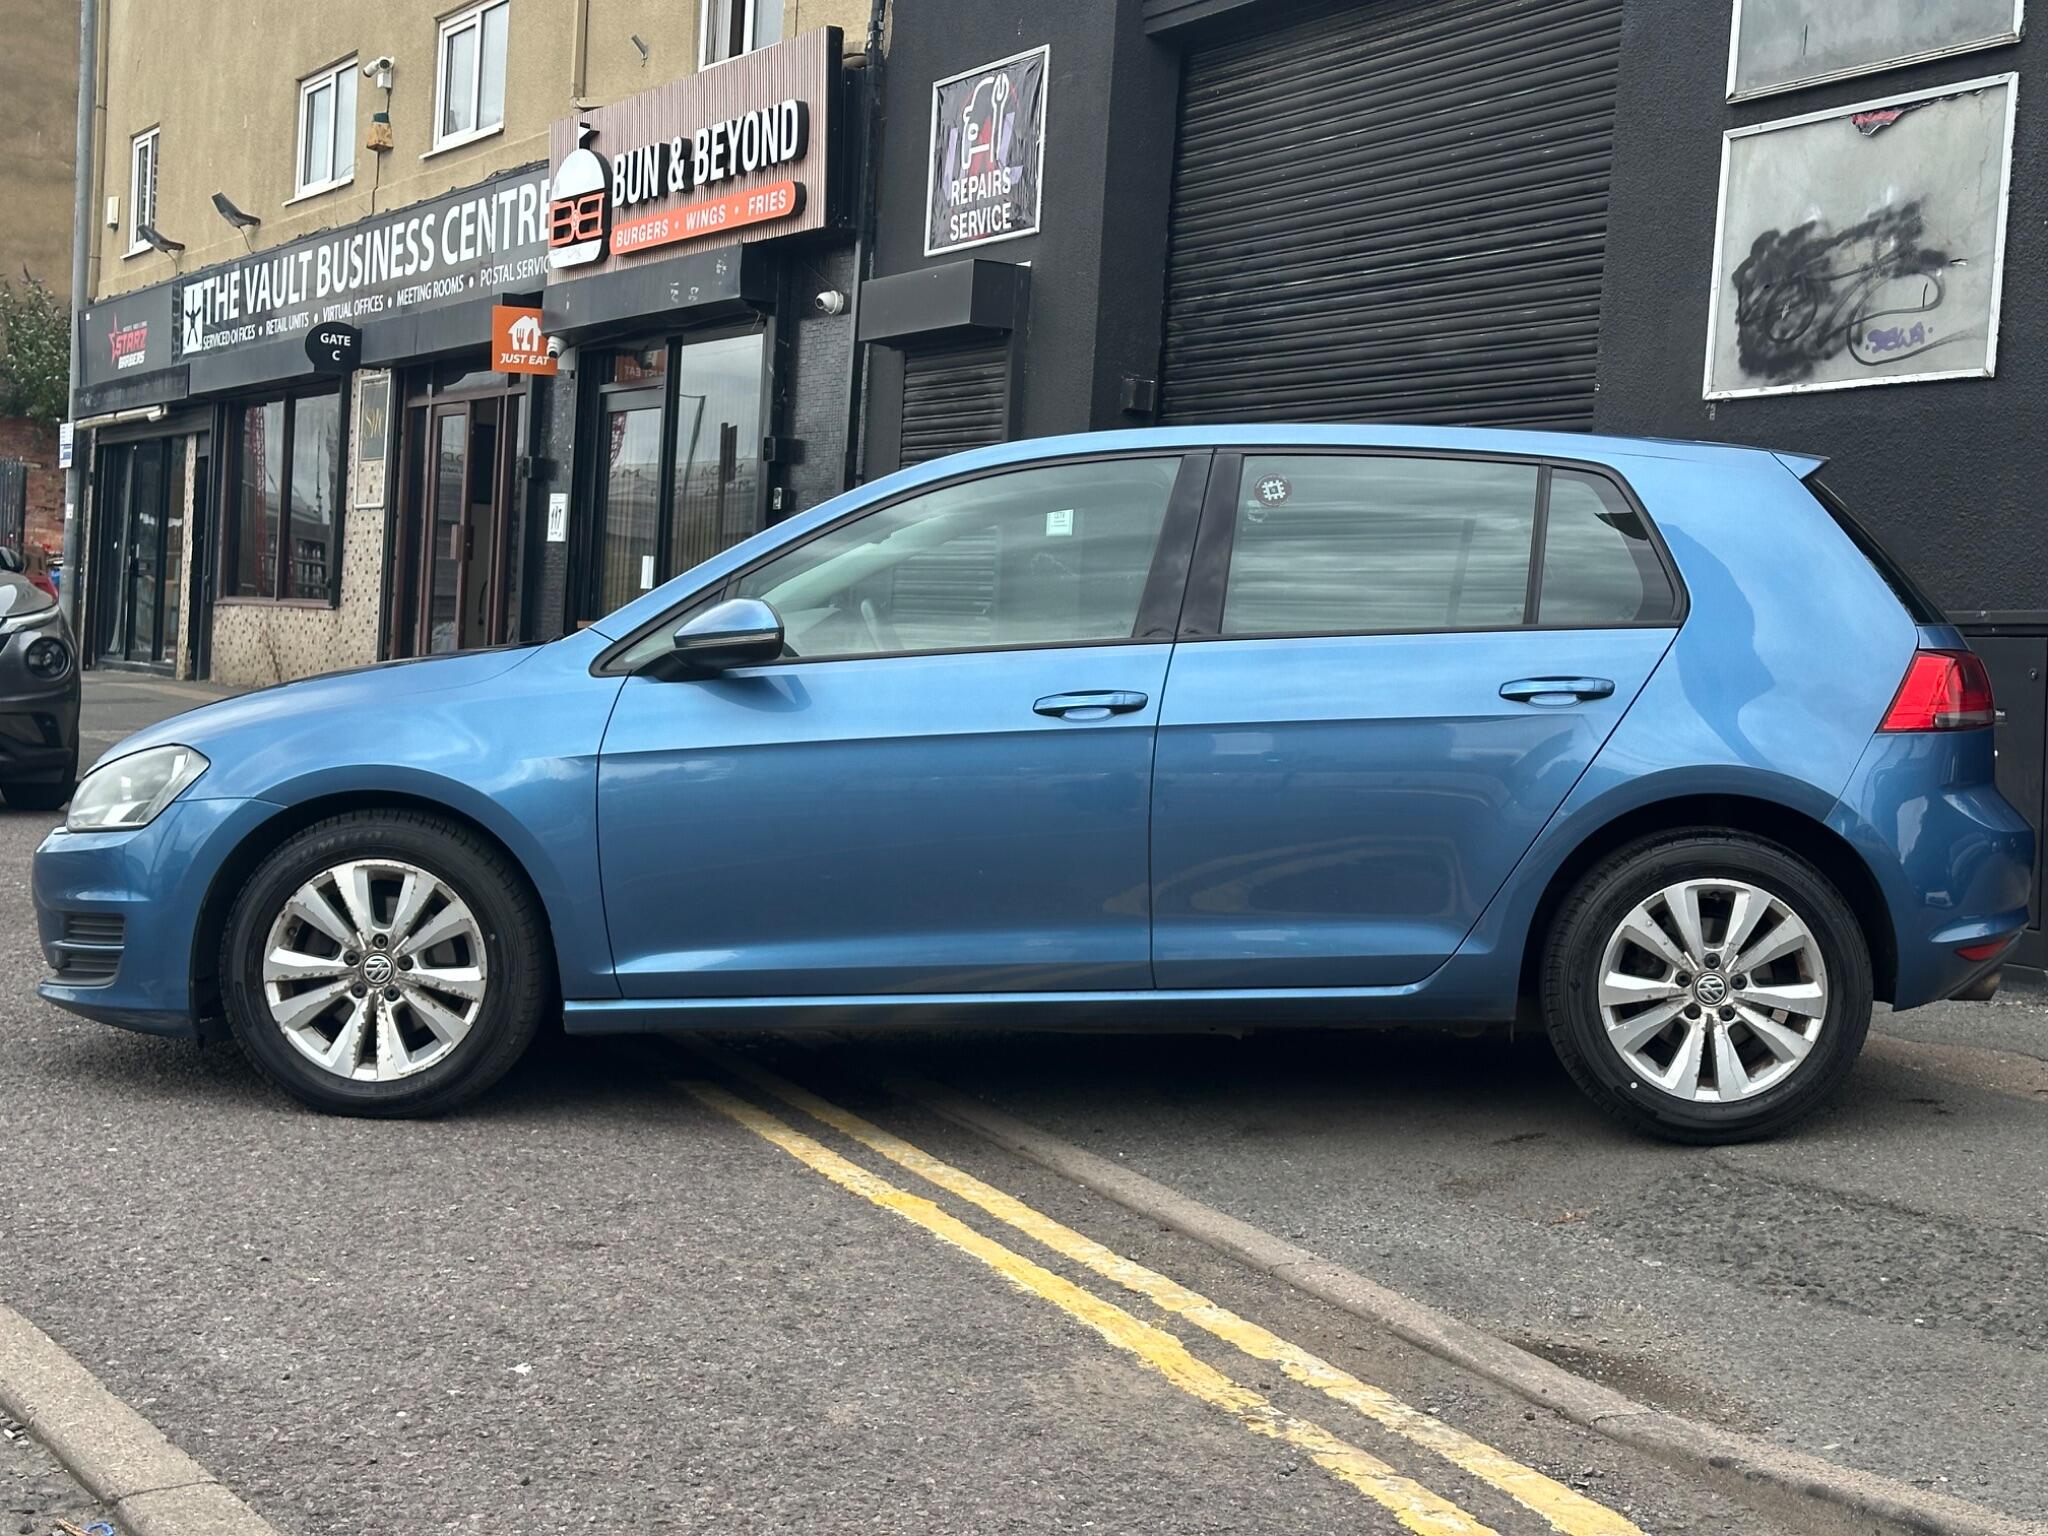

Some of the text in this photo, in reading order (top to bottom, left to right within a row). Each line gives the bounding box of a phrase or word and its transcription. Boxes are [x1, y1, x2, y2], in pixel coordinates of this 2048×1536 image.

[612, 99, 799, 208] BUN & BEYOND
[951, 166, 1012, 207] REPAIRS
[616, 189, 787, 247] BURGERS WINGS FRIES
[950, 202, 1012, 241] SERVICE
[203, 178, 550, 325] THE VAULT BUSINESS CENTRE
[203, 330, 230, 351] SERVICED
[265, 317, 288, 336] RETAIL
[289, 312, 310, 331] UNITS
[322, 301, 353, 322] VIRTUAL
[353, 294, 384, 316] OFFICES
[396, 282, 432, 307] MEETING
[433, 274, 464, 299] ROOMS
[480, 263, 514, 287] POSTAL
[516, 254, 550, 280] SERVIC
[320, 332, 352, 347] GATE
[332, 350, 341, 361] C
[500, 352, 550, 366] JUST EAT
